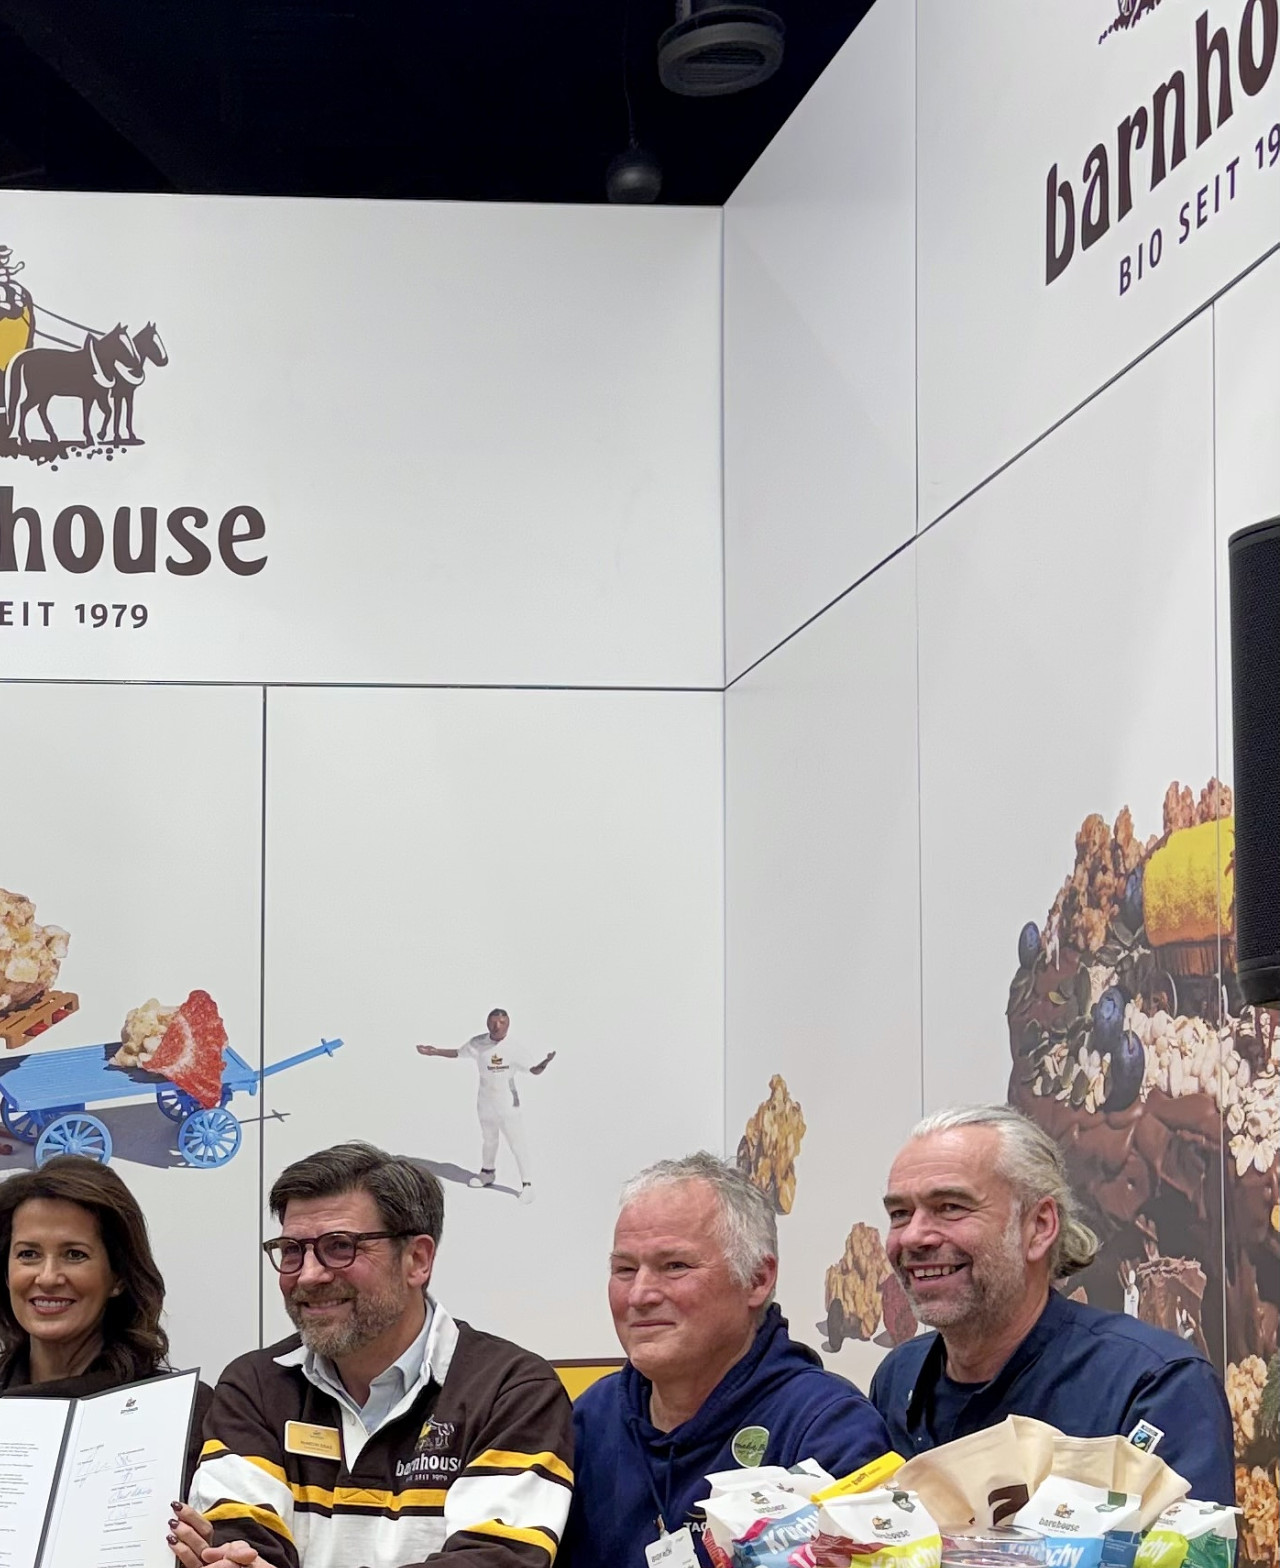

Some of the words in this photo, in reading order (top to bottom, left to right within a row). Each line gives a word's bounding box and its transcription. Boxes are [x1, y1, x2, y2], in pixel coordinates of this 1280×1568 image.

[1120, 228, 1162, 296] BIO
[1179, 156, 1240, 244] SEIT
[74, 603, 148, 629] 1979
